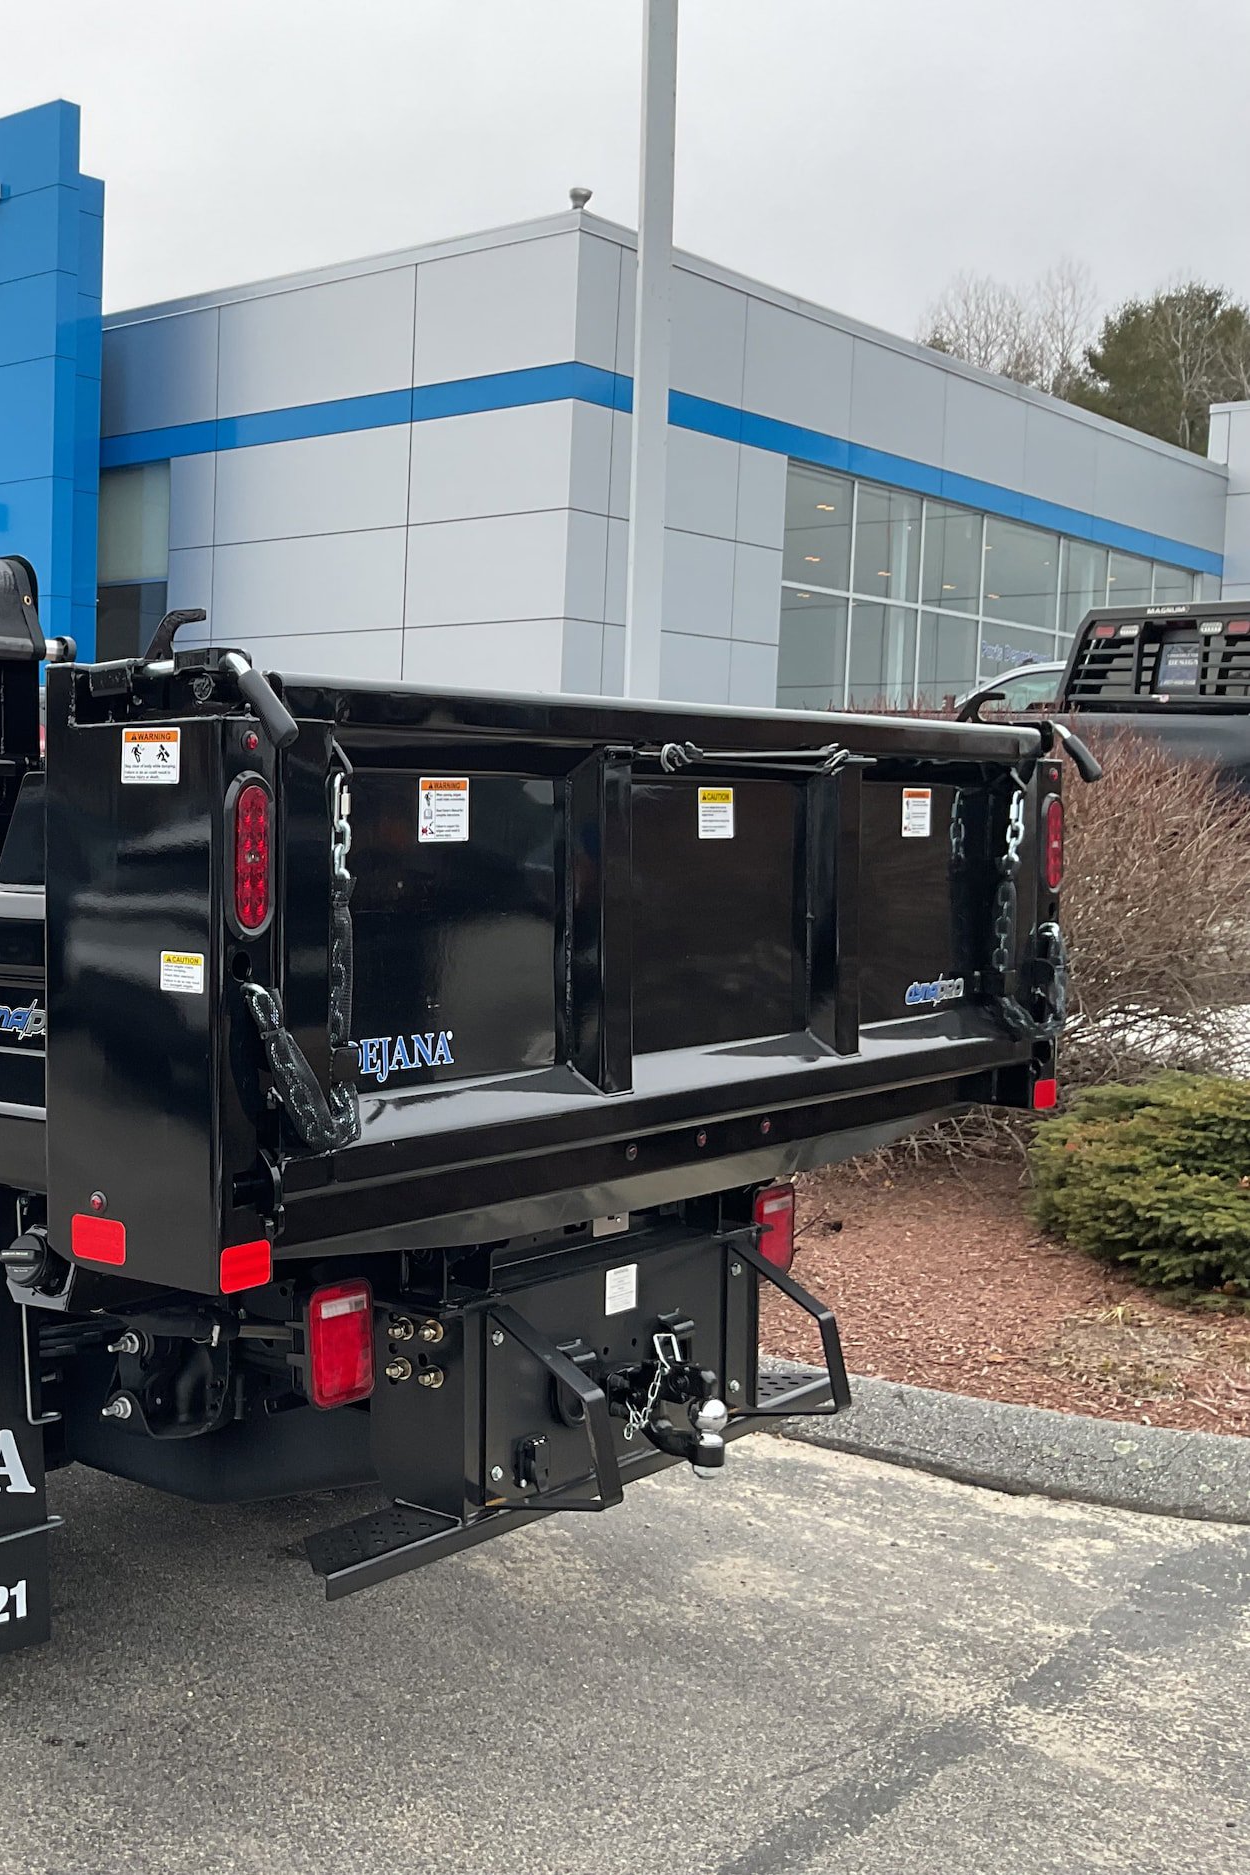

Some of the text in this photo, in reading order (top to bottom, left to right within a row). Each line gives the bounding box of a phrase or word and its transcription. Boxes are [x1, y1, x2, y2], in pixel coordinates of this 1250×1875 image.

[138, 732, 171, 740] WARNING
[172, 956, 199, 964] CAUTION
[348, 1030, 455, 1083] EJANA
